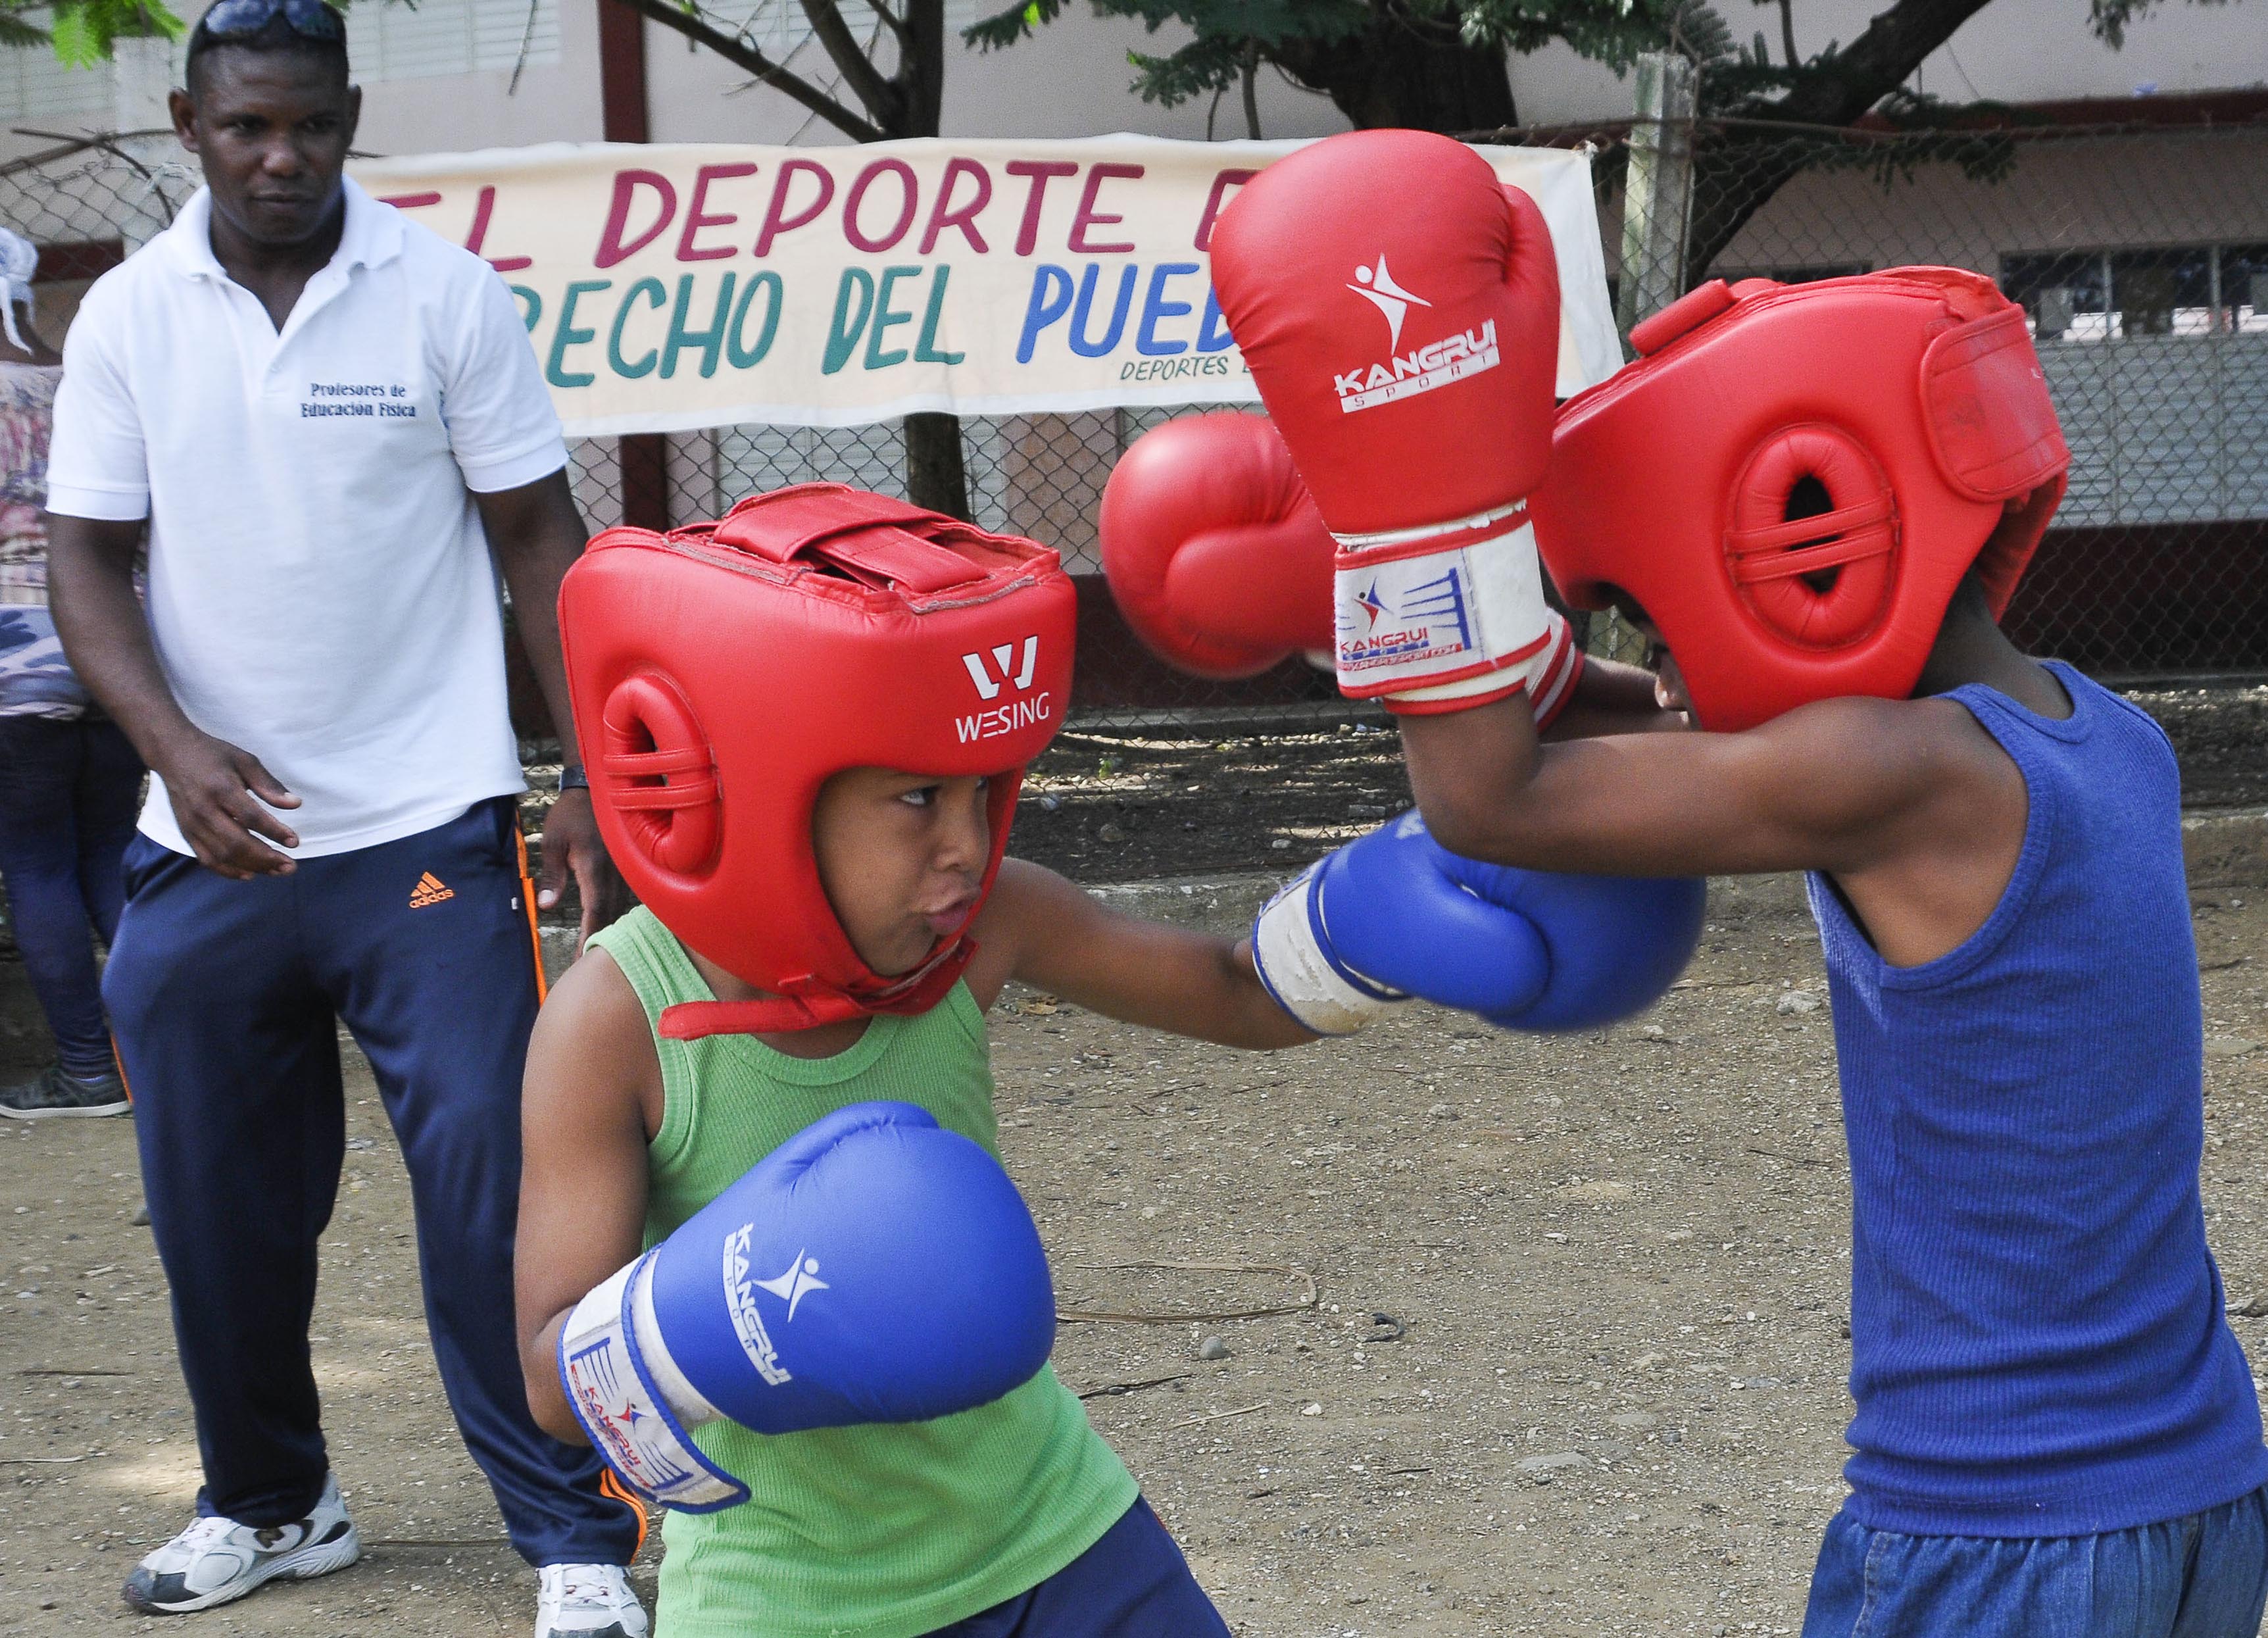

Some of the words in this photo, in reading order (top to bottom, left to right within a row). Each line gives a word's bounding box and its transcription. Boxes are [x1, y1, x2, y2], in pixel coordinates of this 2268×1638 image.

[594, 157, 1145, 268] DEPORTE
[822, 264, 966, 375] DEL
[1120, 356, 1229, 380] DEPORTES
[1334, 318, 1498, 397] KANGRUI
[310, 382, 385, 396] Profesores
[391, 384, 406, 397] de
[1341, 627, 1428, 653] KANGRUI
[956, 691, 1050, 744] WESING
[409, 889, 454, 908] adidas
[734, 1222, 792, 1382] KANGRUI
